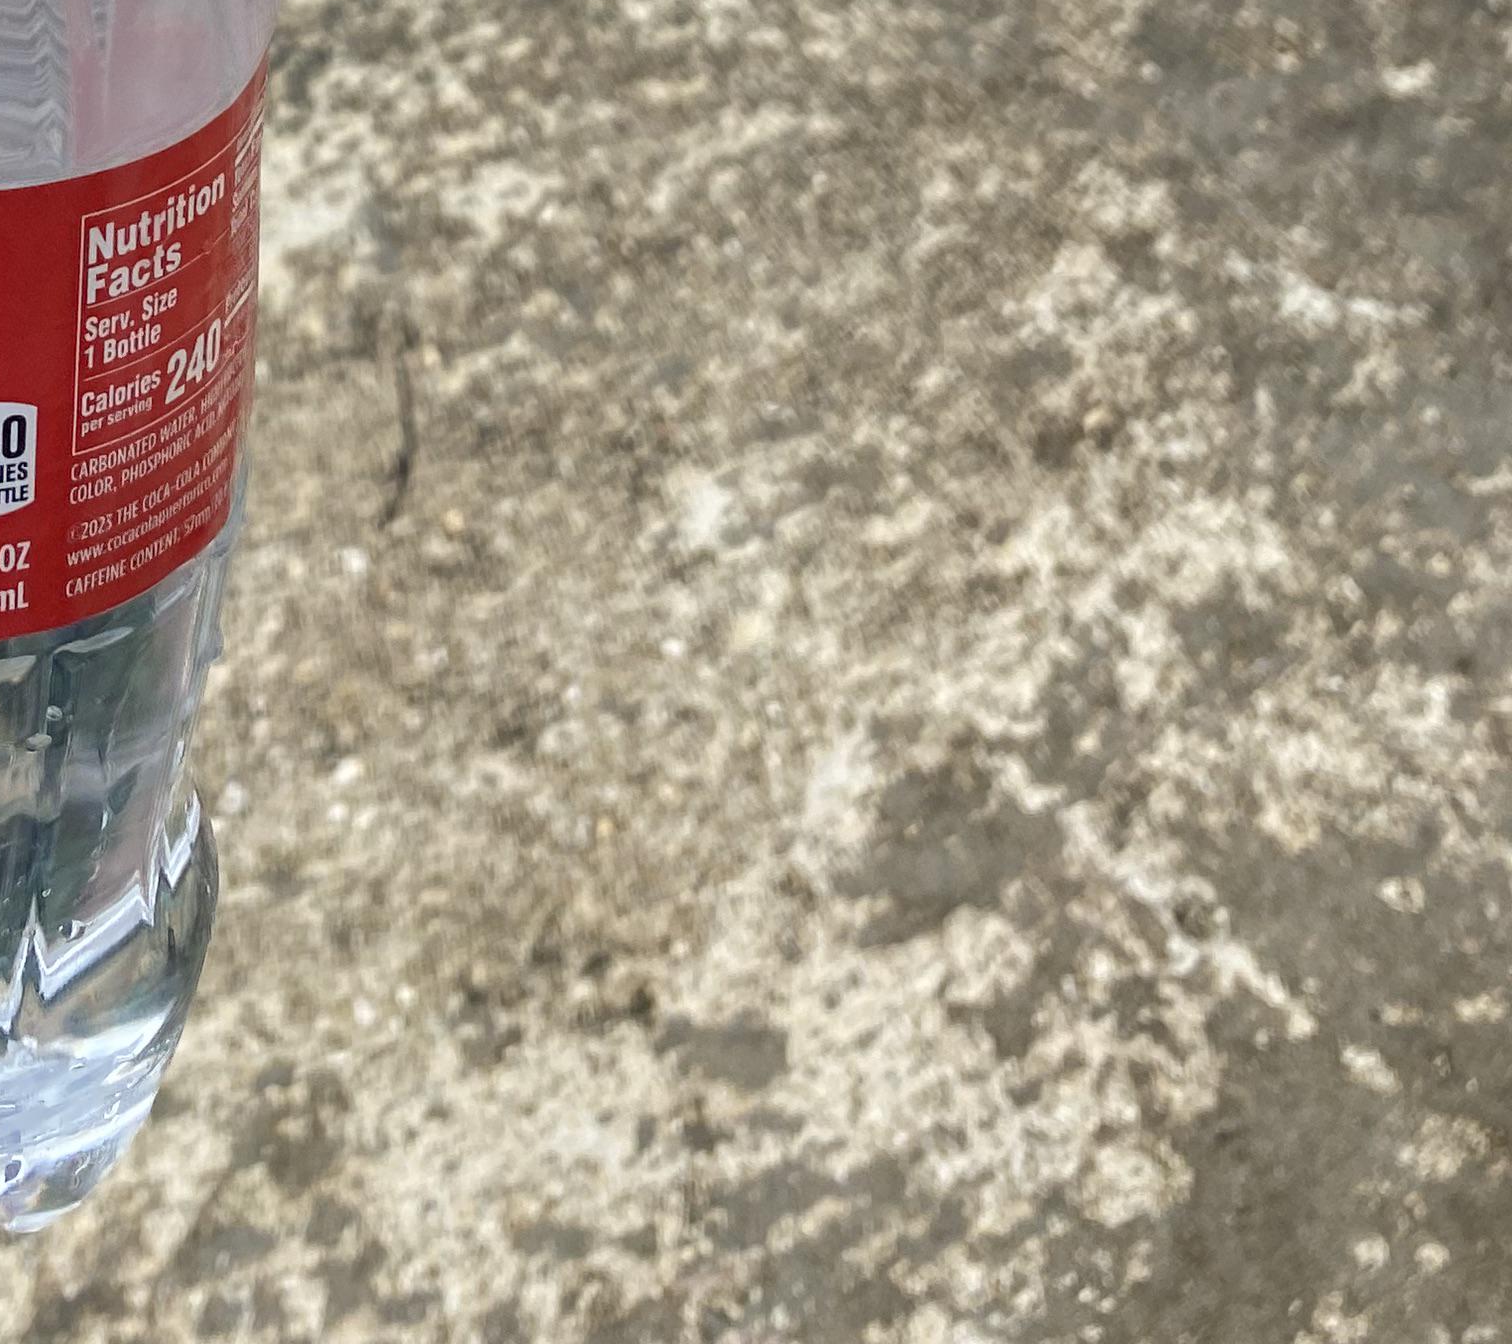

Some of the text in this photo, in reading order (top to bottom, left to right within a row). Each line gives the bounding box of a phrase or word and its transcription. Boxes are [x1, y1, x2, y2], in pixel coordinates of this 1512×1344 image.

[88, 172, 225, 265] Nutrition
[86, 242, 182, 304] Facts
[84, 287, 178, 342] Serv. Size
[81, 369, 162, 418] Calories
[164, 317, 222, 405] 240
[84, 323, 161, 369] 1 Bottle
[81, 396, 153, 438] per serving
[70, 431, 157, 483] CARBONATED
[116, 499, 140, 525] THE
[65, 558, 128, 599] CAFFEINE
